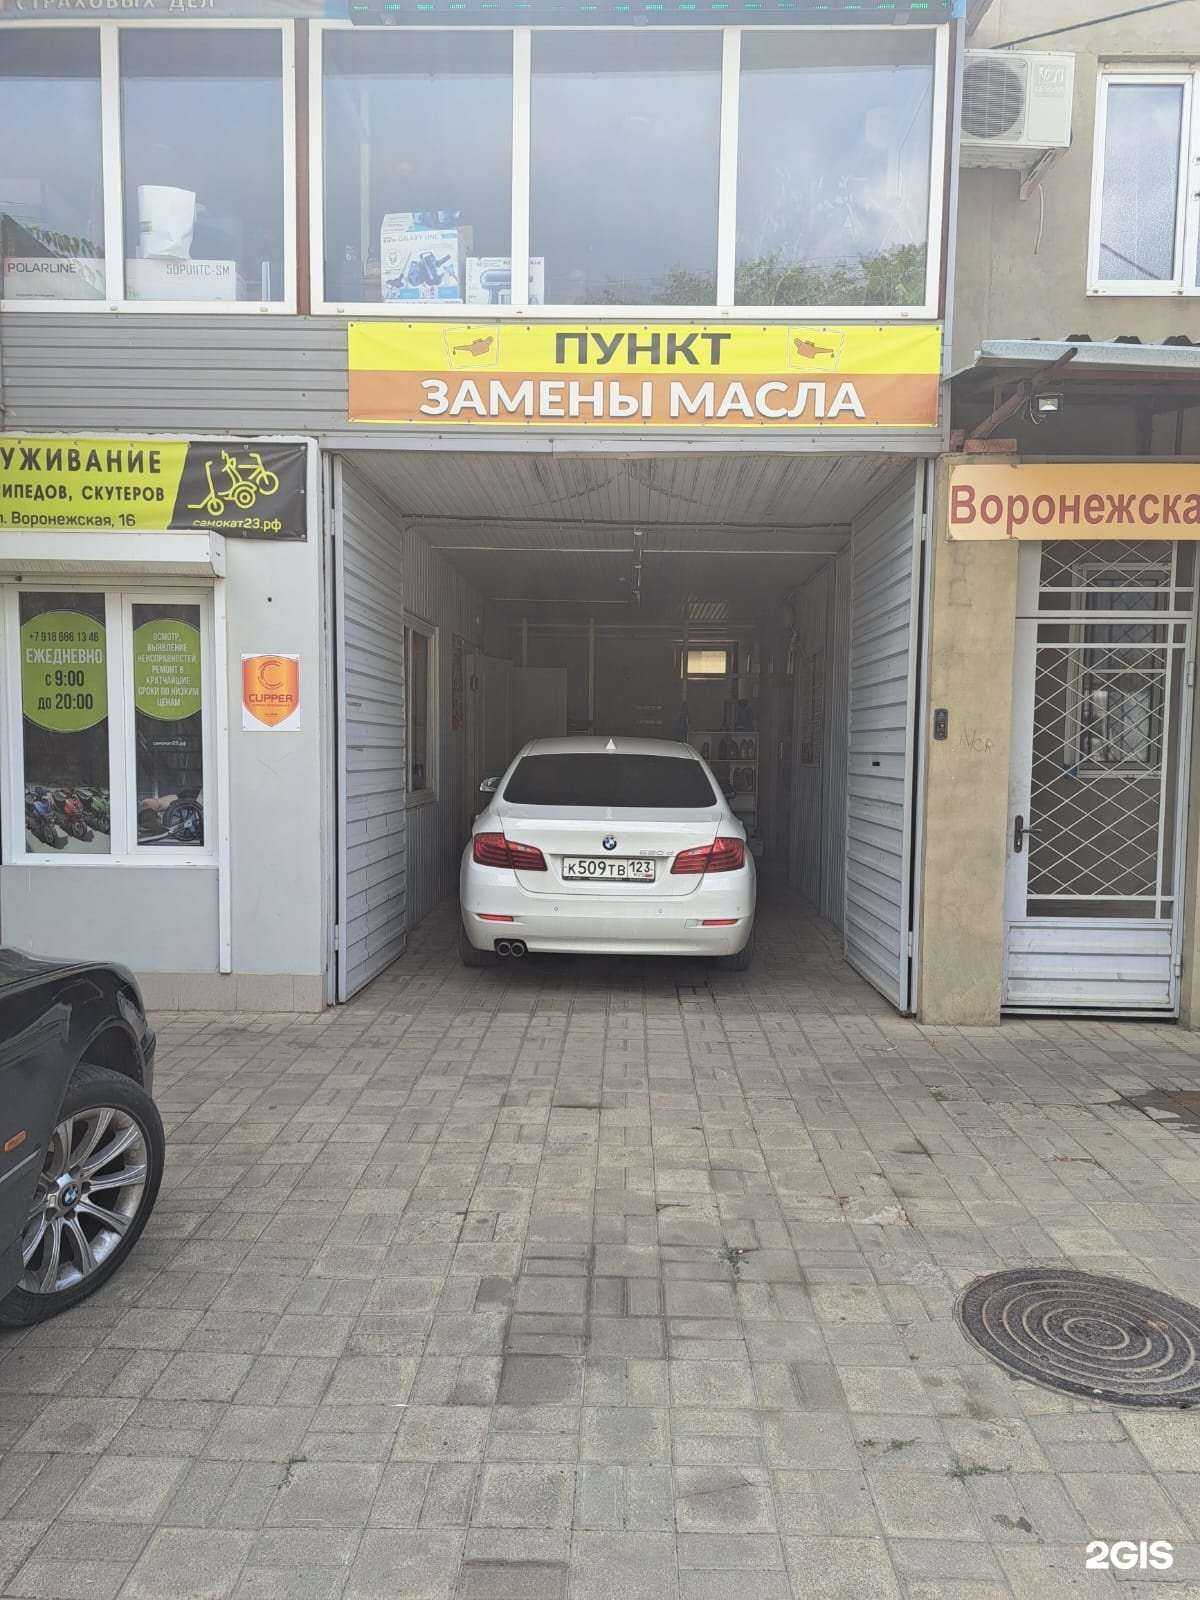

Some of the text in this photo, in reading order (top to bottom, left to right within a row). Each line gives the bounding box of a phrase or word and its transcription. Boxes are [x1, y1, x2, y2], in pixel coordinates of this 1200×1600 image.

[7, 262, 77, 273] POLARLINE
[555, 331, 732, 365] ПУНКТ
[420, 378, 866, 419] ЗАМЕНЫ МАСЛА
[0, 447, 161, 474] УЖИВАНИЕ
[82, 485, 165, 501] СКУТЕРОВ
[950, 484, 1200, 536] Воронежска
[11, 511, 115, 528] Воронежская,
[118, 513, 136, 527] 16
[192, 517, 282, 533] самокат23.рф
[26, 648, 103, 665] ЕЖЕДНЕВНО
[55, 670, 85, 686] 9:00
[38, 693, 94, 711] до 20:00
[248, 694, 293, 702] CUPPER
[629, 861, 651, 873] 123
